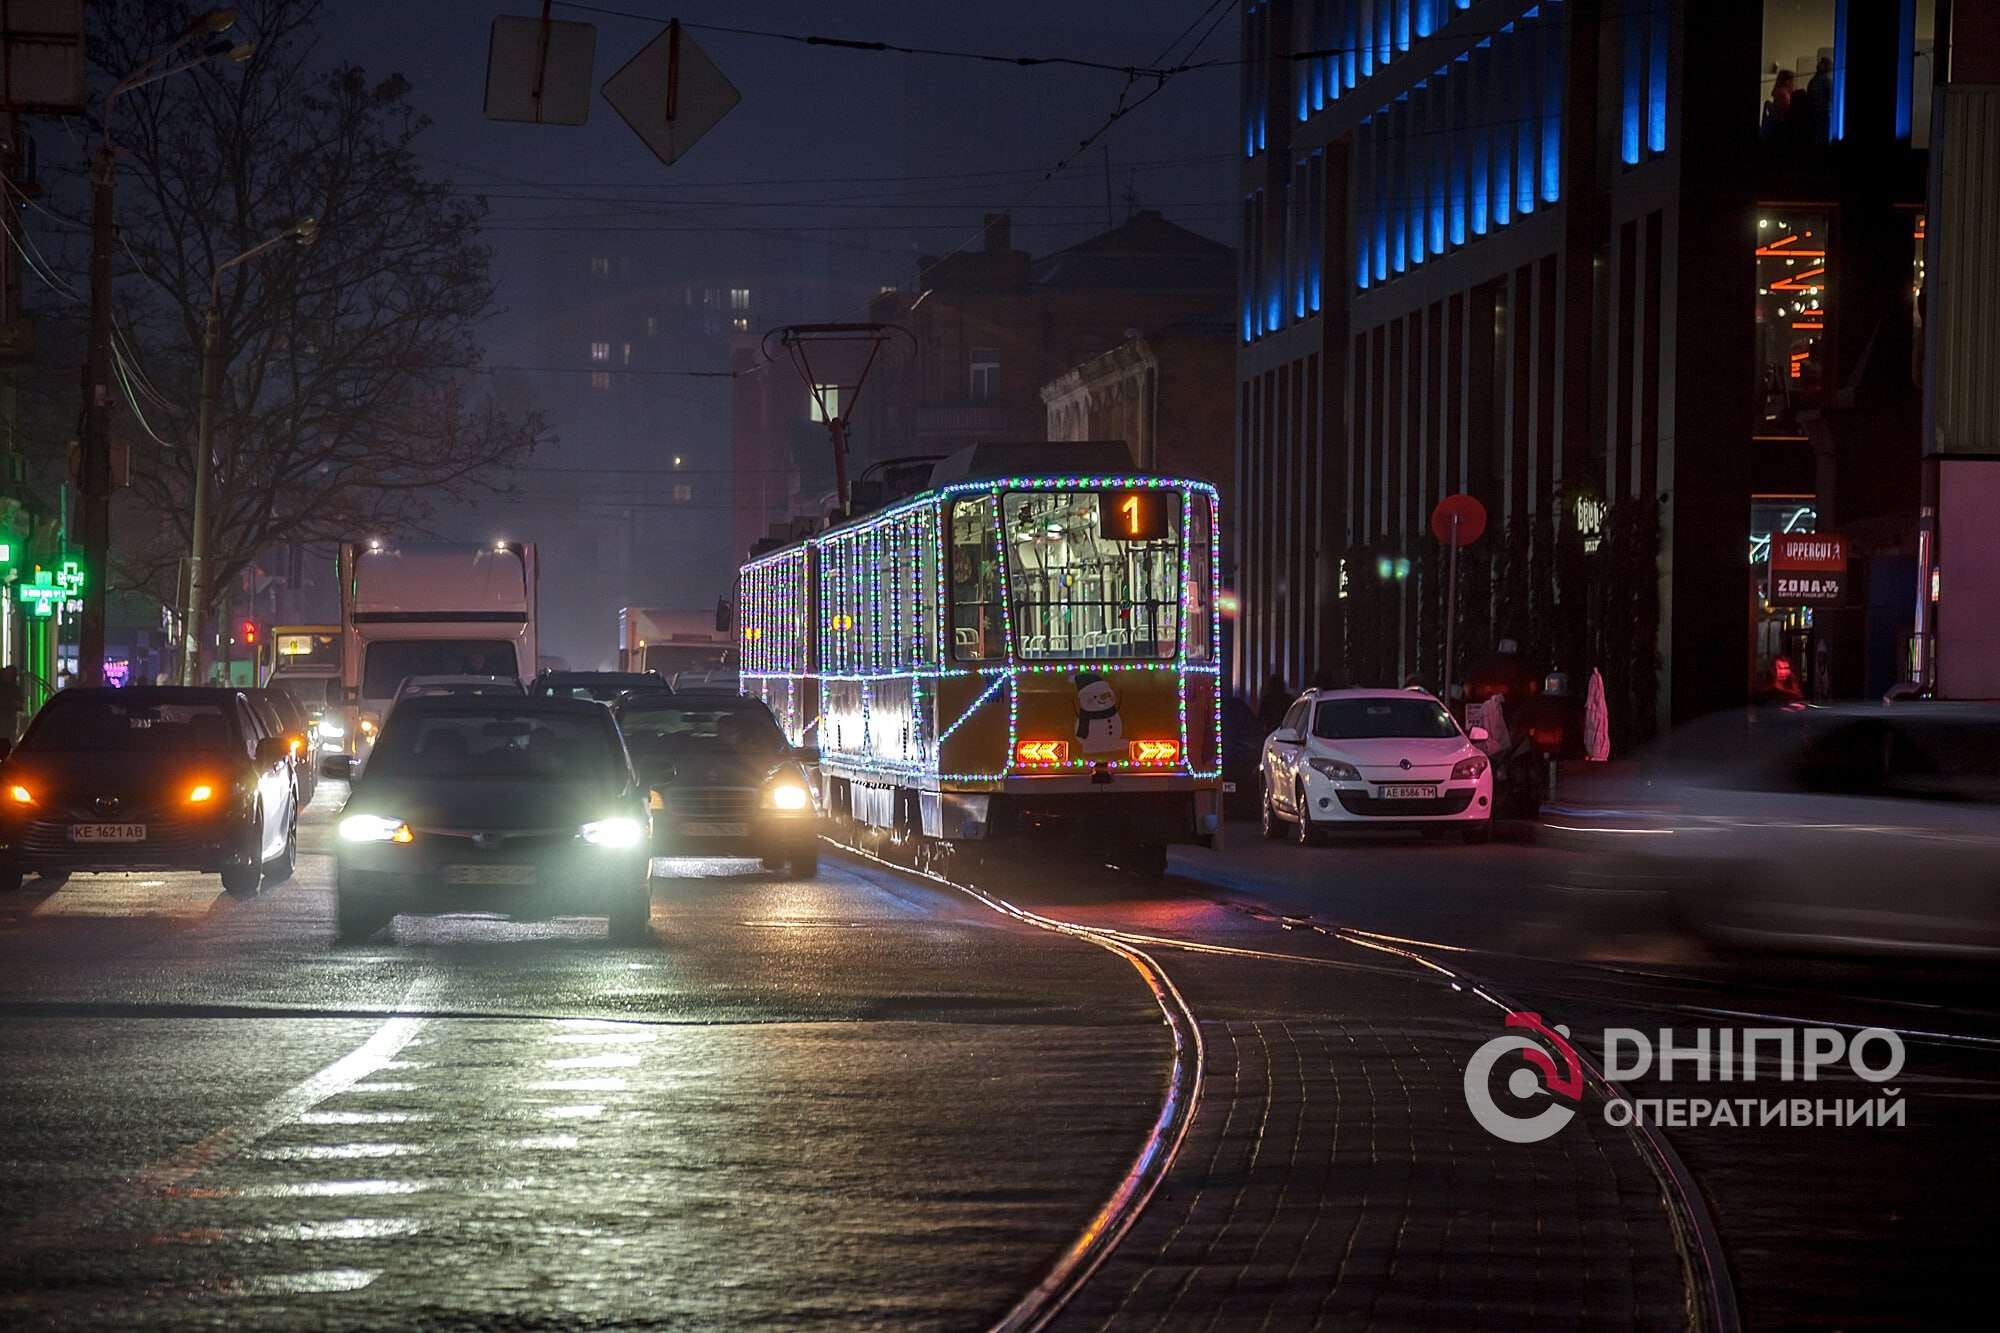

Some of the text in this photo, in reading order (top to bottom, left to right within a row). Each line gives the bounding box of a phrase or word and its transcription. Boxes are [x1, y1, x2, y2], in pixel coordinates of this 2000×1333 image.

[1122, 496, 1138, 534] 1
[1787, 542, 1831, 558] UPPERCUT
[1778, 579, 1821, 593] ZONA
[1386, 788, 1398, 797] AE
[75, 827, 143, 838] KE 1621 AB
